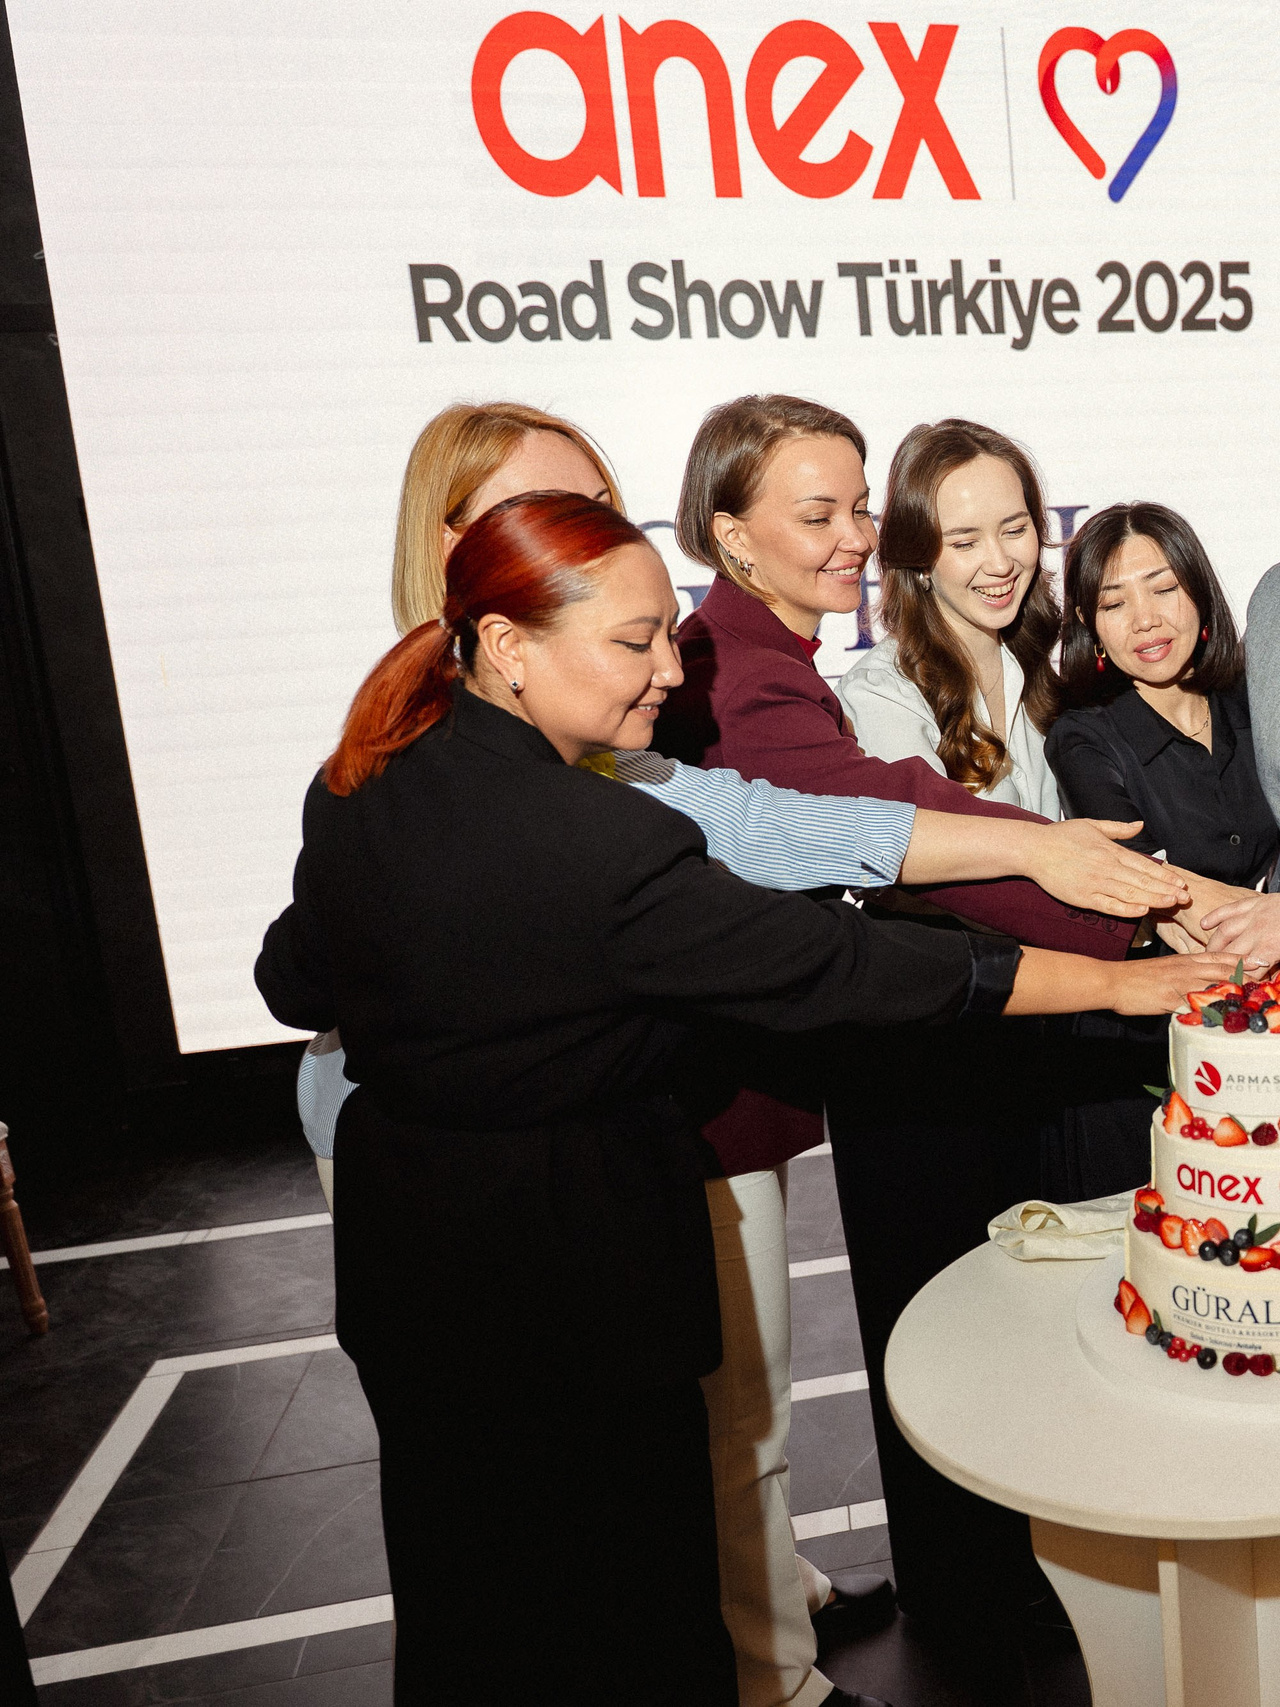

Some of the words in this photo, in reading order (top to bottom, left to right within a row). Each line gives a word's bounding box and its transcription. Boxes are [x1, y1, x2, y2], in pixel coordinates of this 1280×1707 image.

[471, 11, 981, 200] anex
[409, 260, 610, 342] Road
[628, 260, 822, 339] Show
[838, 260, 1080, 350] Türkiye
[1097, 261, 1252, 332] 2025
[1226, 1073, 1280, 1085] ARMAS
[1177, 1164, 1263, 1204] anex
